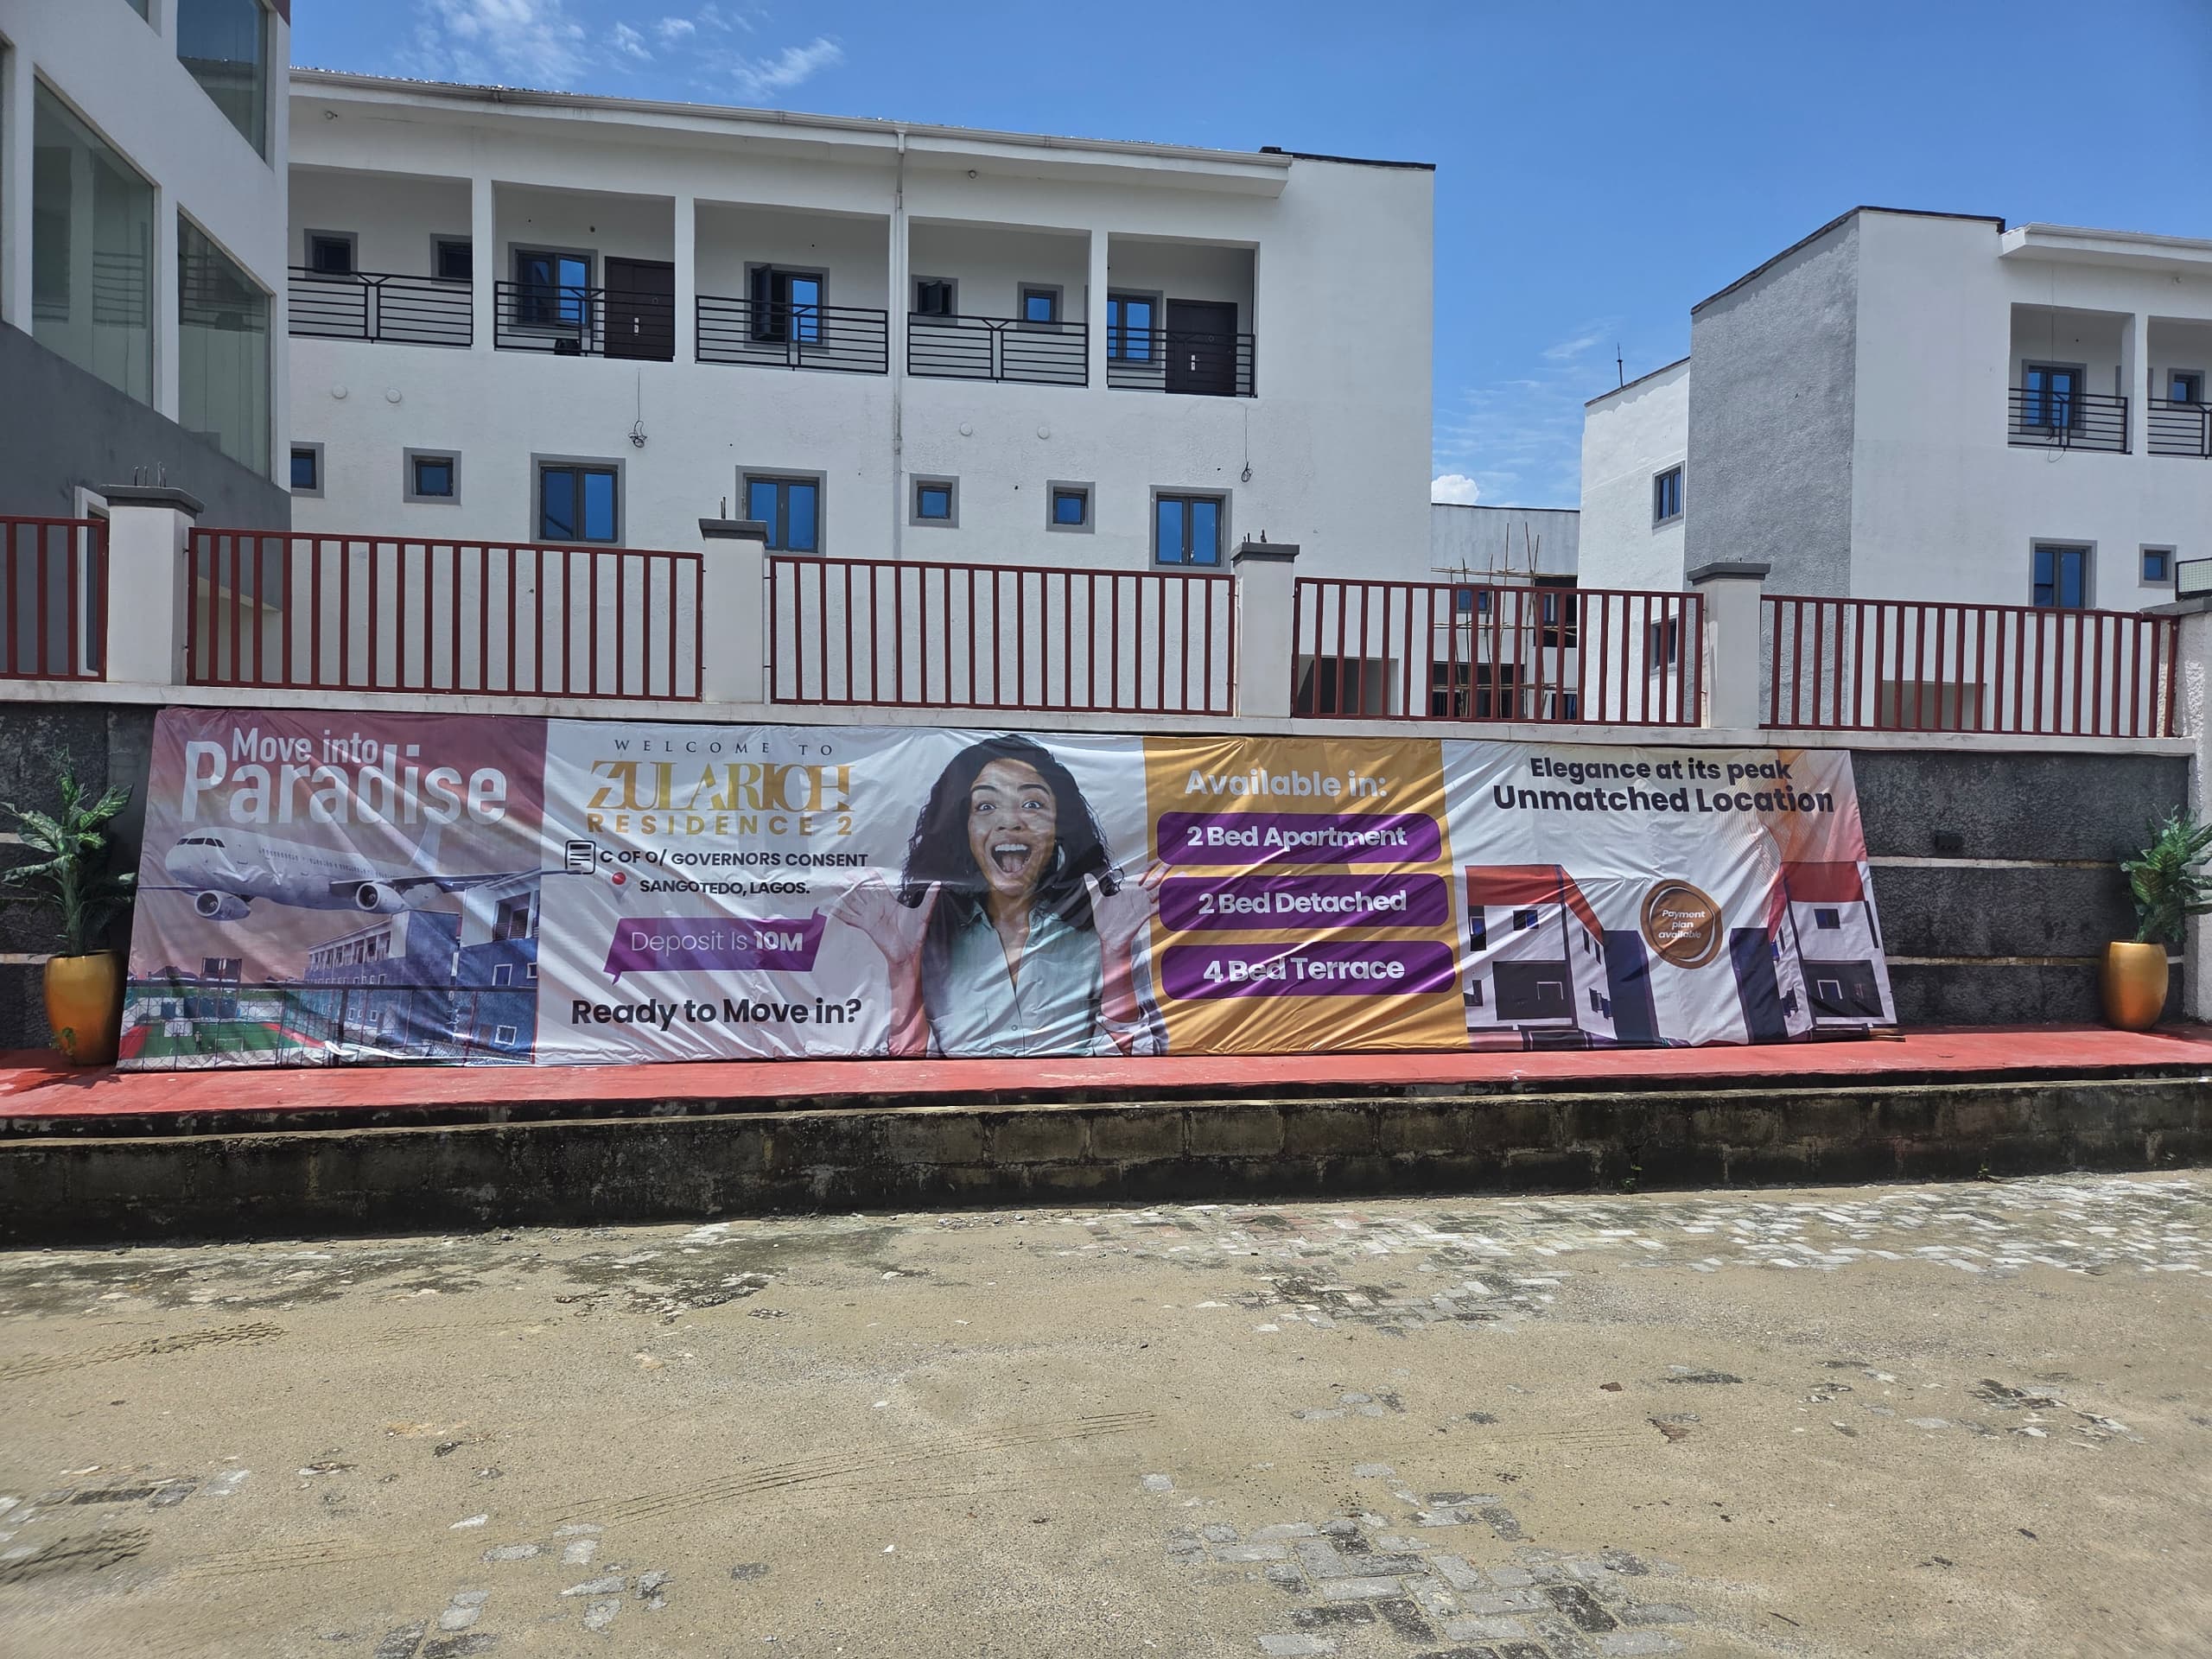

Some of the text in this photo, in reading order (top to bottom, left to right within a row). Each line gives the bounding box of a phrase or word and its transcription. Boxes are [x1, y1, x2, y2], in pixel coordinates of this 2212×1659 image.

[232, 727, 378, 765] Move into
[614, 740, 832, 756] WELCOME TO
[181, 741, 507, 825] Paradise
[1185, 769, 1388, 797] Available in:
[1530, 758, 1790, 785] Elegance at its peak
[587, 760, 855, 813] ZULARICH
[1493, 785, 1834, 812] Unmatched Location
[588, 815, 852, 836] RESIDENCE 2
[1187, 826, 1408, 851] 2 Bed Apartment
[600, 850, 613, 863] C
[617, 850, 641, 863] OF
[671, 853, 781, 866] GOVERNORS
[785, 854, 868, 868] CONSENT
[639, 880, 810, 898] SANGOTEDO, LAGOS.
[1198, 890, 1407, 914] 2 Bed Detached
[1662, 909, 1706, 919] Payment
[1672, 921, 1694, 930] plan
[632, 930, 803, 957] Deposit Is 10M
[1204, 957, 1405, 982] 4 Bed Terrace
[571, 998, 862, 1031] Ready to Move in?
